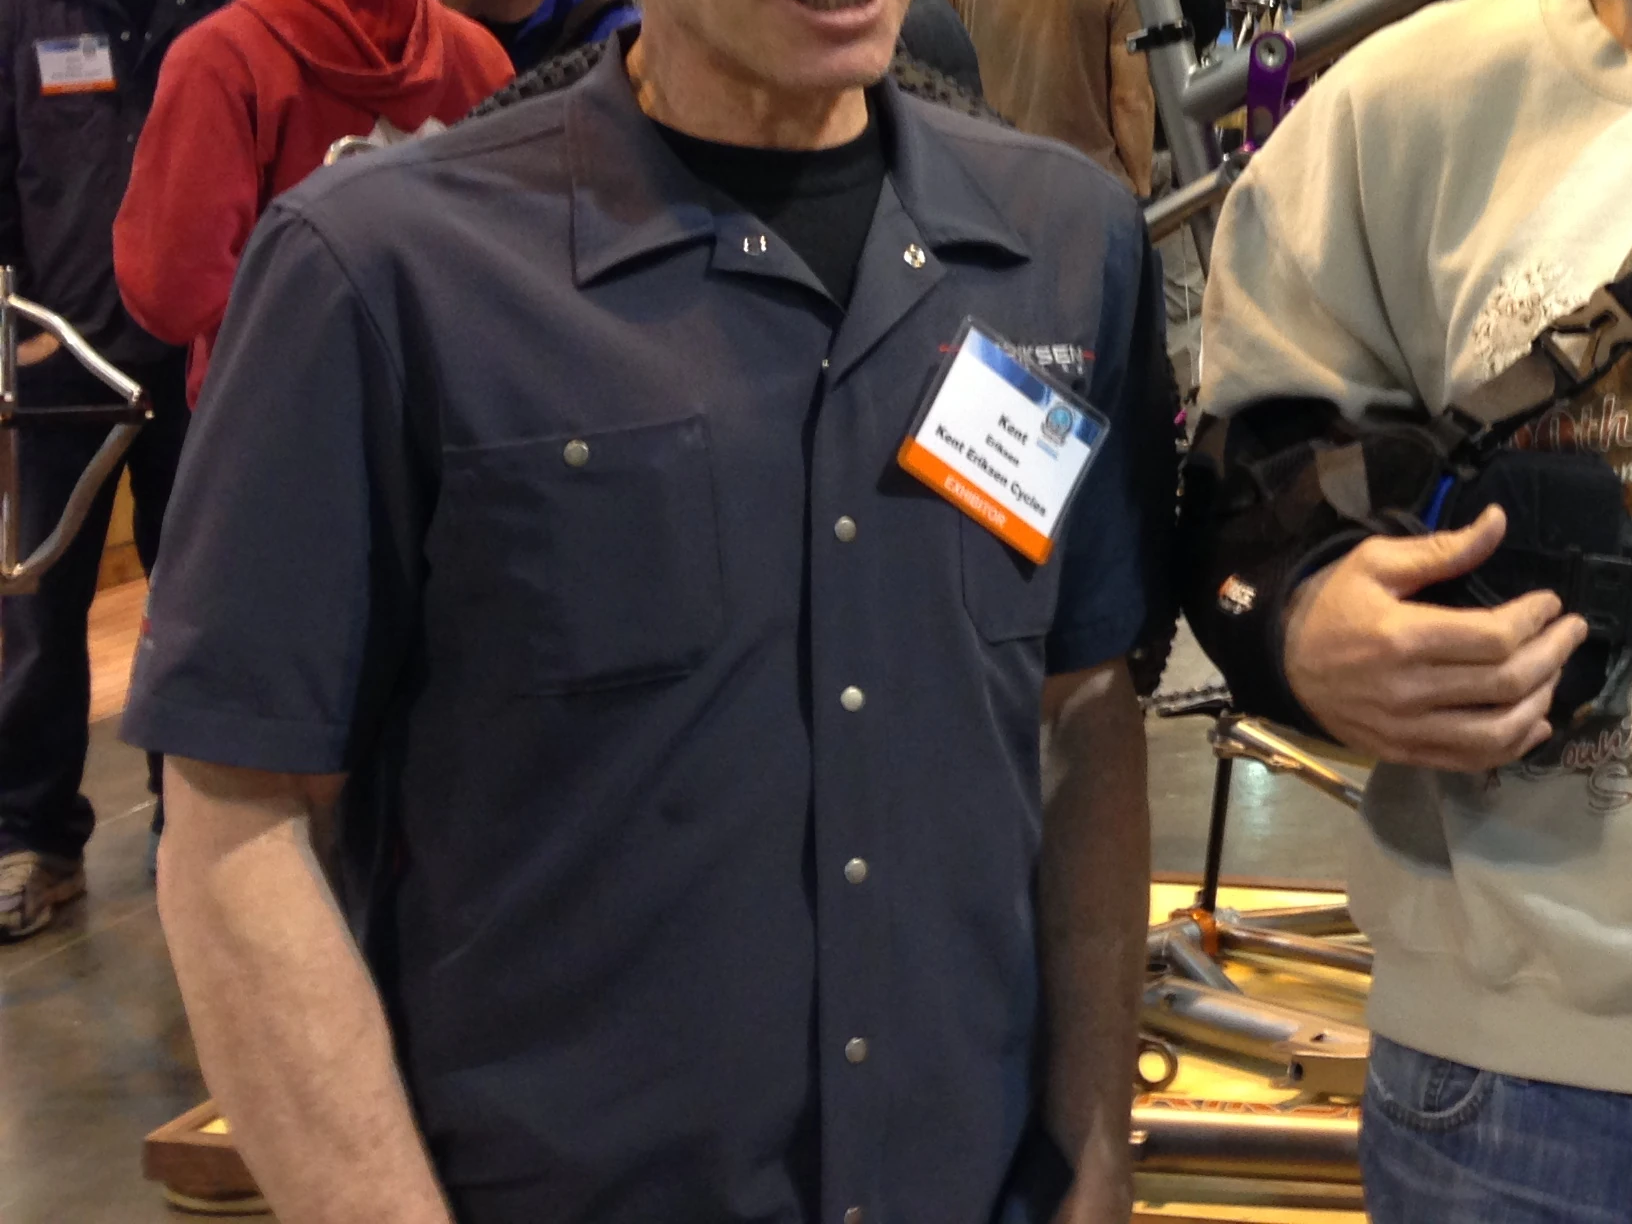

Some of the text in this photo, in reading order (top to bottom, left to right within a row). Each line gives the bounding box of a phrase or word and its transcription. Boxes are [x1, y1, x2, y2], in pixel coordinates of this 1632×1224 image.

[984, 433, 1020, 468] Eriksen
[998, 413, 1030, 447] Kent
[934, 423, 1047, 518] Kent Eriksen Cycles
[943, 475, 1007, 528] EXHIBITOR
